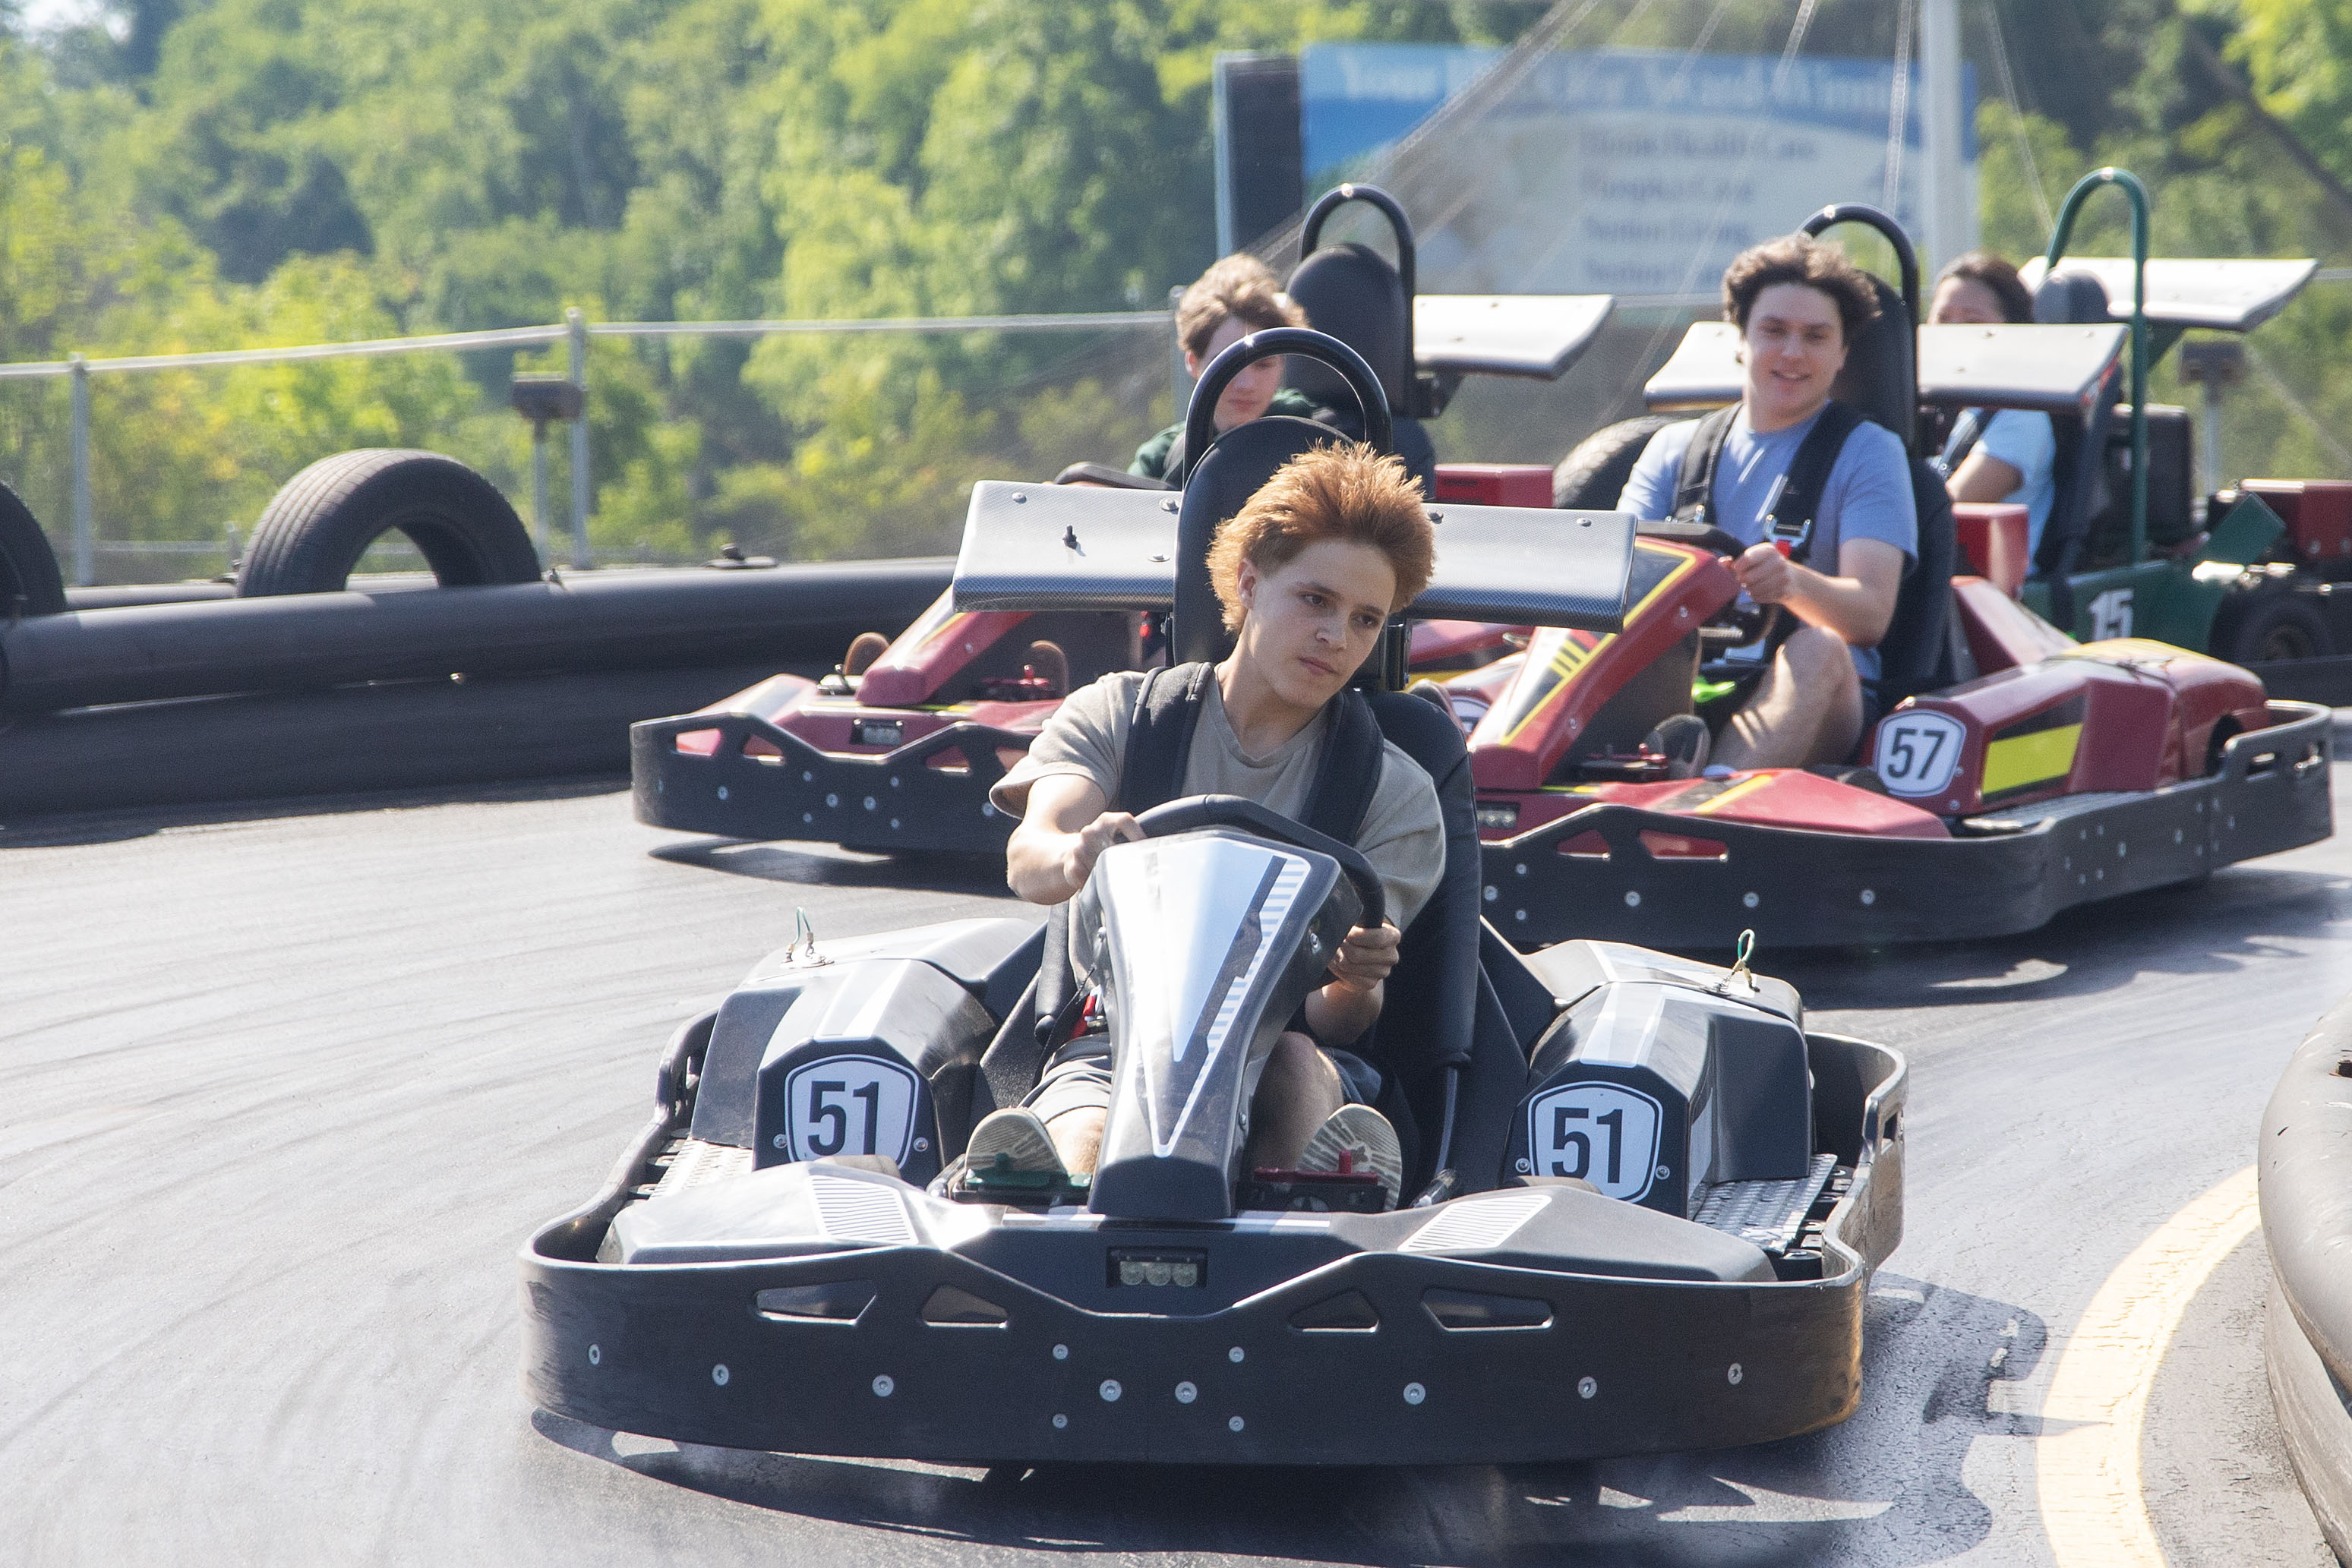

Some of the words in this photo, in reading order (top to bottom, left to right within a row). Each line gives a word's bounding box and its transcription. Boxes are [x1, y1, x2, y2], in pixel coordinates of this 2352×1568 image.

[2089, 588, 2133, 641] 15
[1887, 727, 1947, 779] 57
[807, 1081, 879, 1156] 51
[1552, 1106, 1623, 1184] 51
